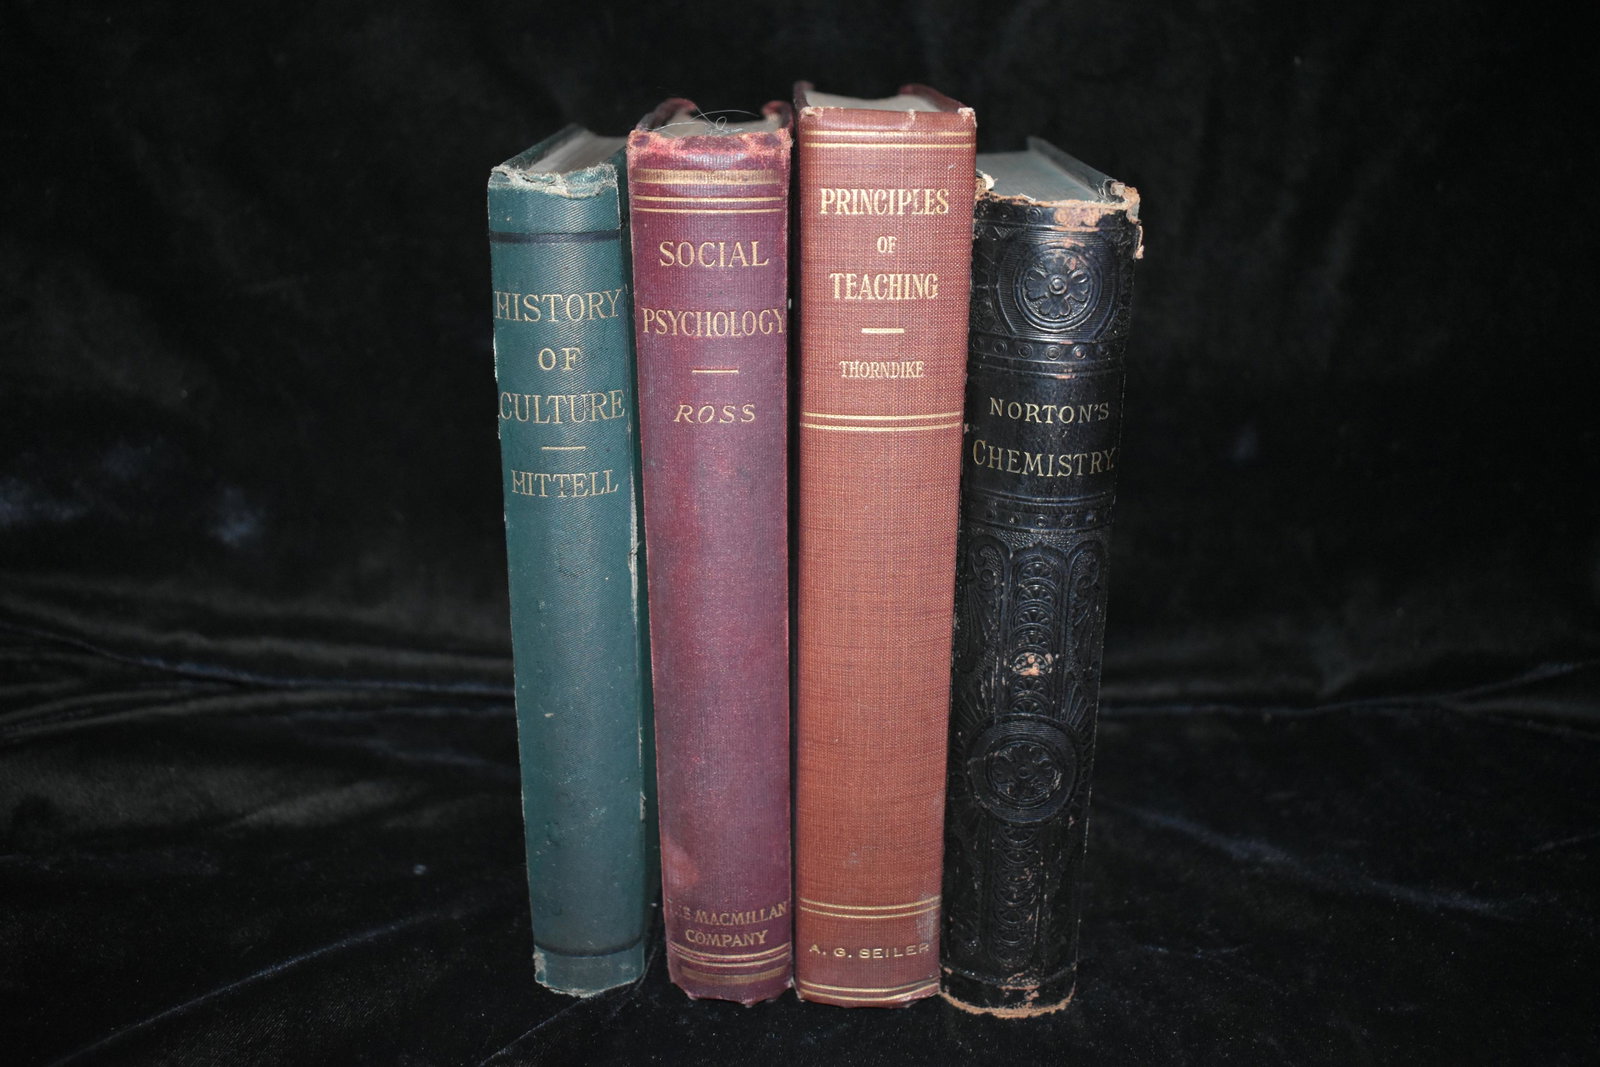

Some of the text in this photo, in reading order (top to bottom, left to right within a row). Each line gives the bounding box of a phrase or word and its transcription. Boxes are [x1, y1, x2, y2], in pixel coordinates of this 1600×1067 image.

[819, 188, 949, 215] PRINCIPLES
[659, 241, 769, 268] SOCIAL
[876, 236, 897, 253] OF
[829, 273, 938, 300] TEACHING
[494, 289, 622, 322] HISTORY
[641, 308, 786, 337] PSYCHOLOGY
[537, 347, 581, 371] OF
[839, 360, 925, 379] THORNDIKE
[499, 390, 625, 424] CULTURE
[674, 404, 756, 424] ROSS
[989, 397, 1109, 424] NORTON'S
[695, 901, 787, 926] MACMILLAN
[685, 929, 768, 947] COMPANY
[809, 942, 929, 959] A. G. SEILER
